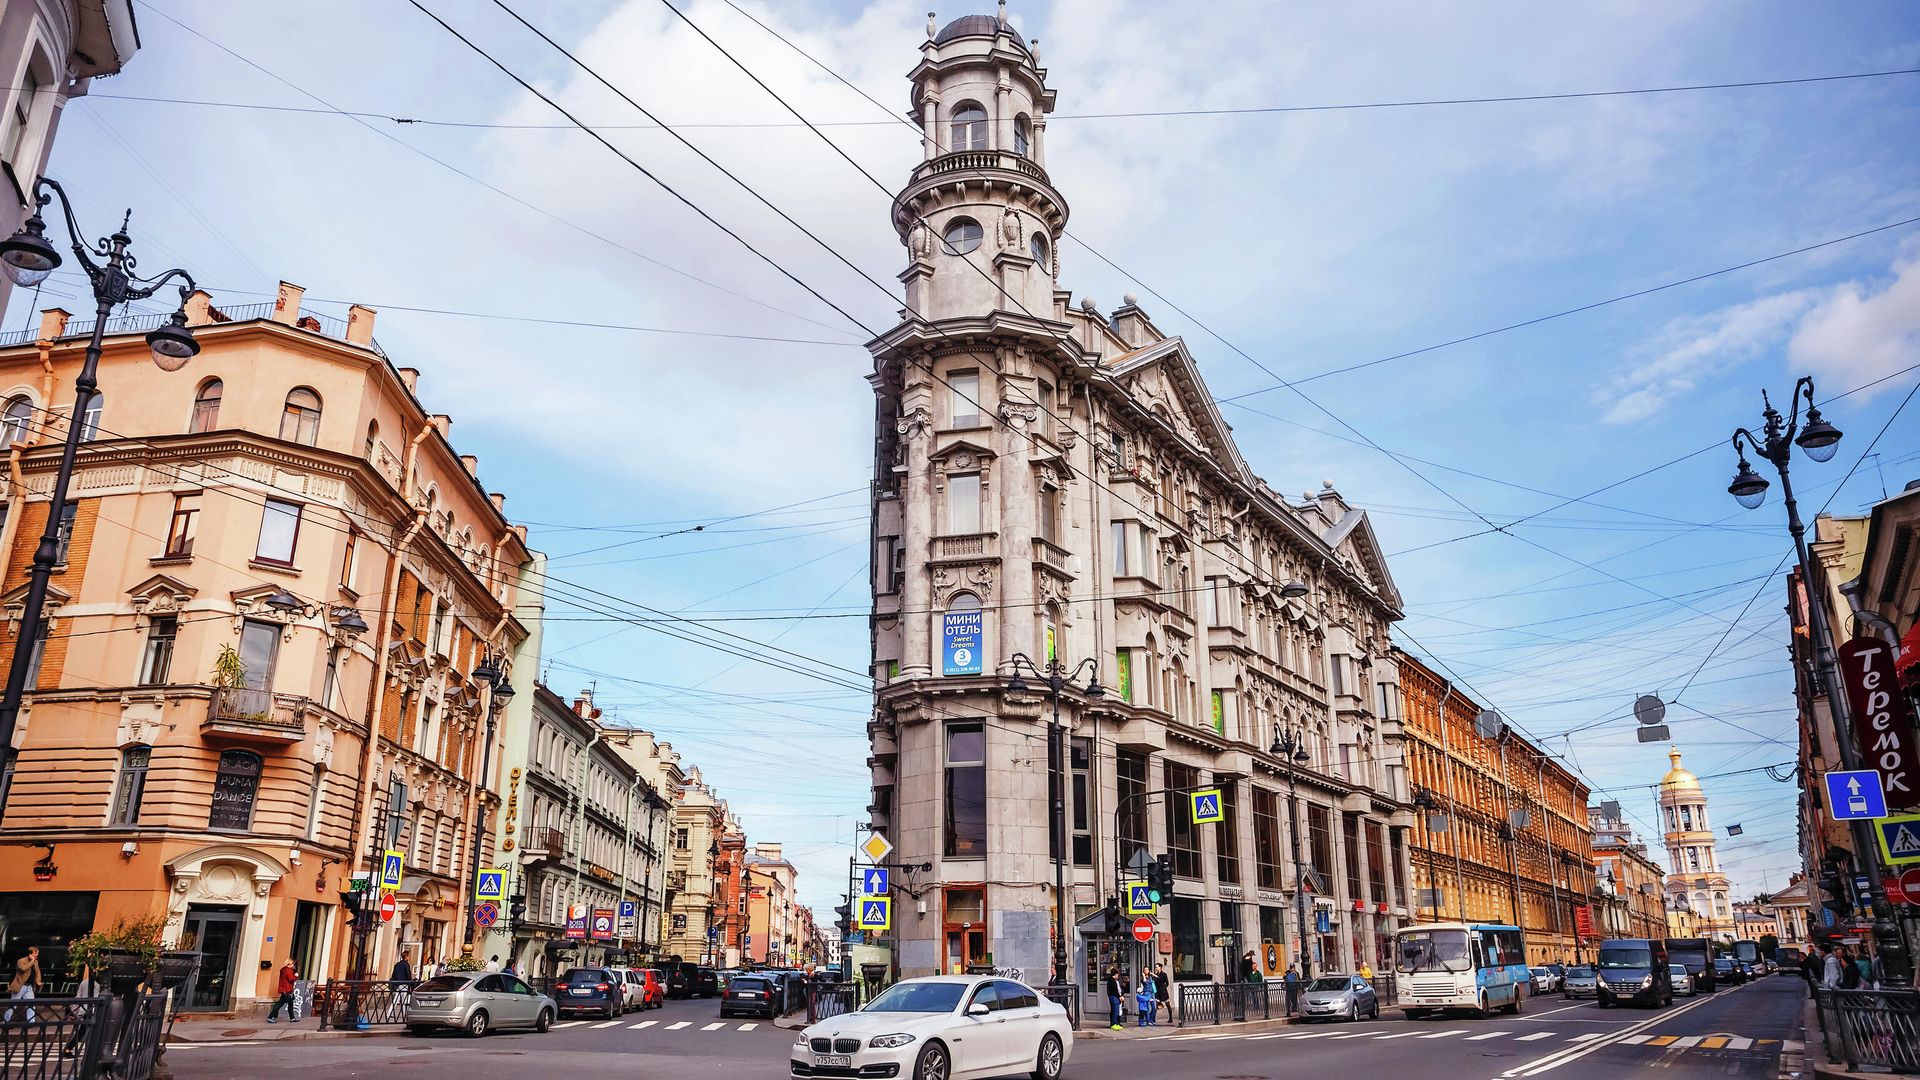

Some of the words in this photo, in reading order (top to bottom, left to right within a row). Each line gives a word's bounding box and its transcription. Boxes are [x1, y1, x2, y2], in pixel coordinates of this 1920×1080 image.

[946, 614, 980, 625] МИНИ
[946, 625, 981, 635] ОТЕЛЬ
[959, 650, 966, 660] 3
[1853, 647, 1911, 792] Теремок
[221, 758, 257, 771] BLACK
[220, 775, 252, 788] PUMA
[213, 791, 253, 803] DANCE
[505, 767, 521, 834] ОТЕЛЬ
